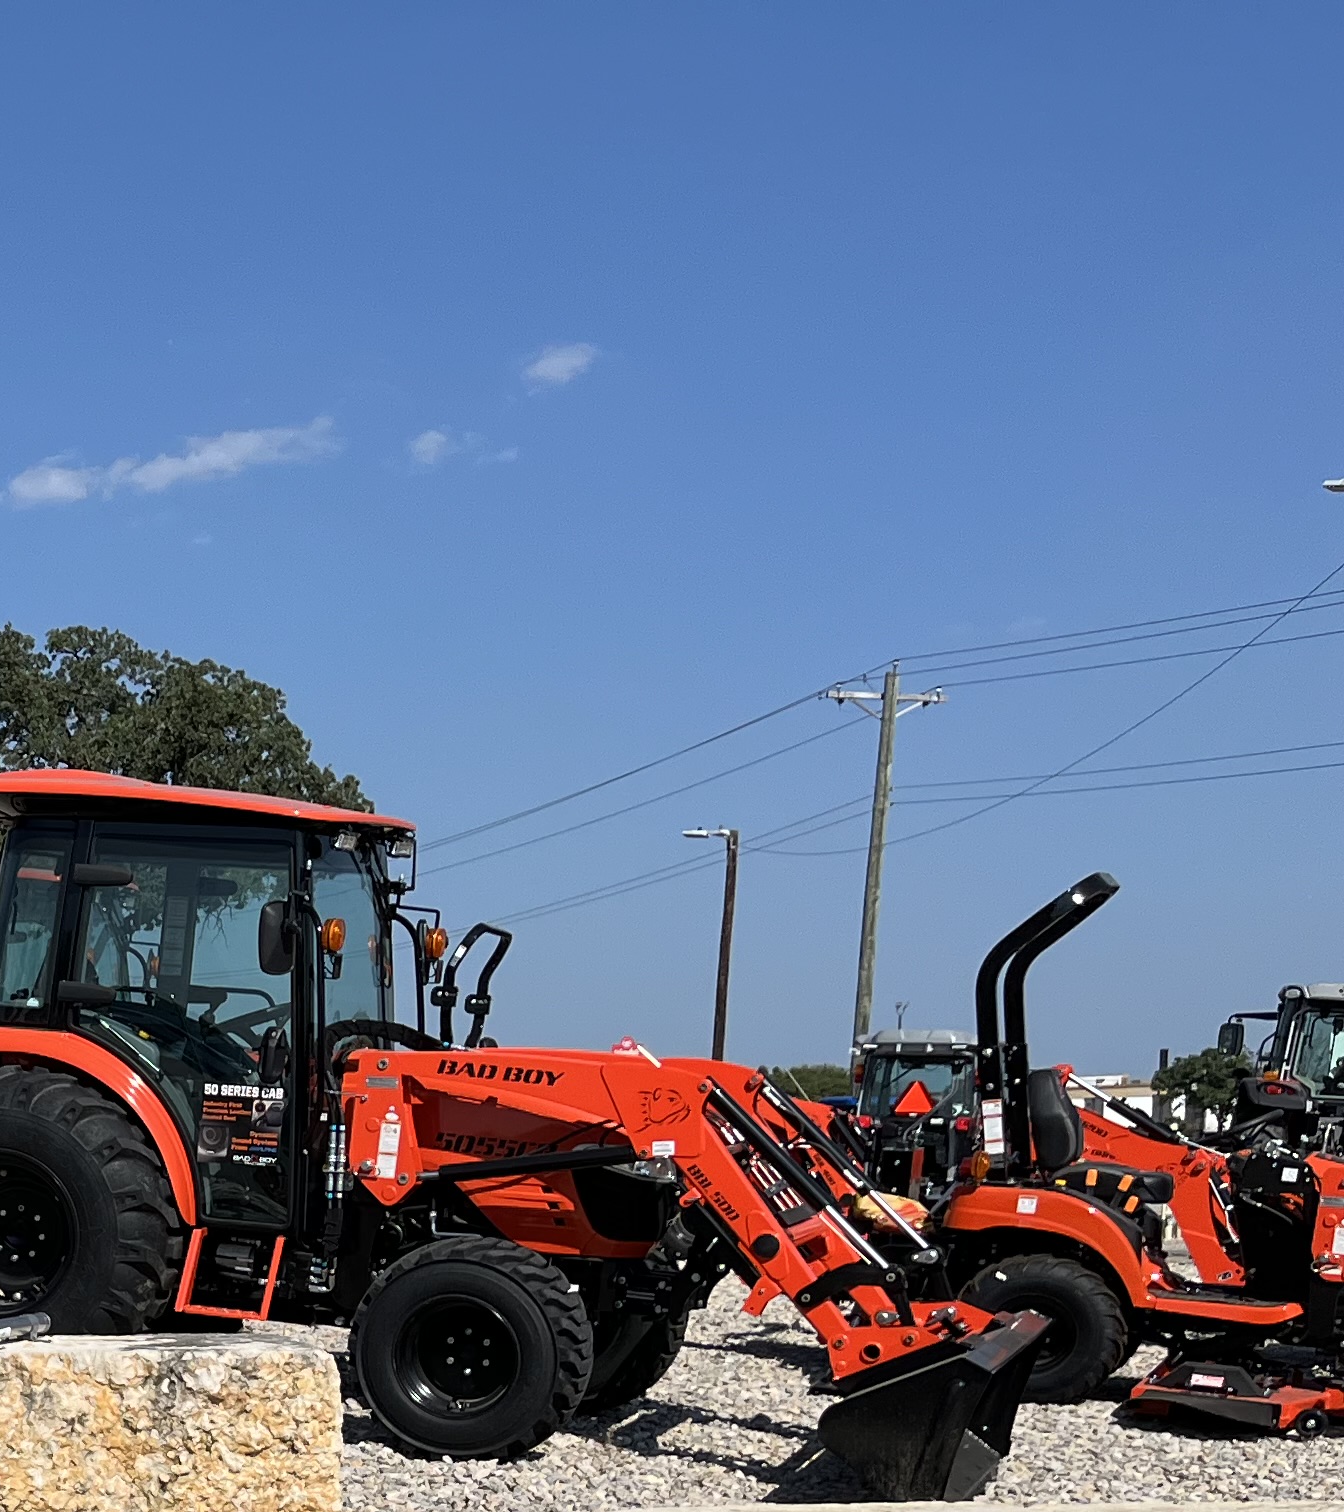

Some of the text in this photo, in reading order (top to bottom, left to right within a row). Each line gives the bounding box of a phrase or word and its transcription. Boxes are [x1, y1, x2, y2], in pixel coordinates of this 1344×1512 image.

[437, 1059, 565, 1087] BAD BOY
[204, 1083, 284, 1100] 50 SERIES CAB
